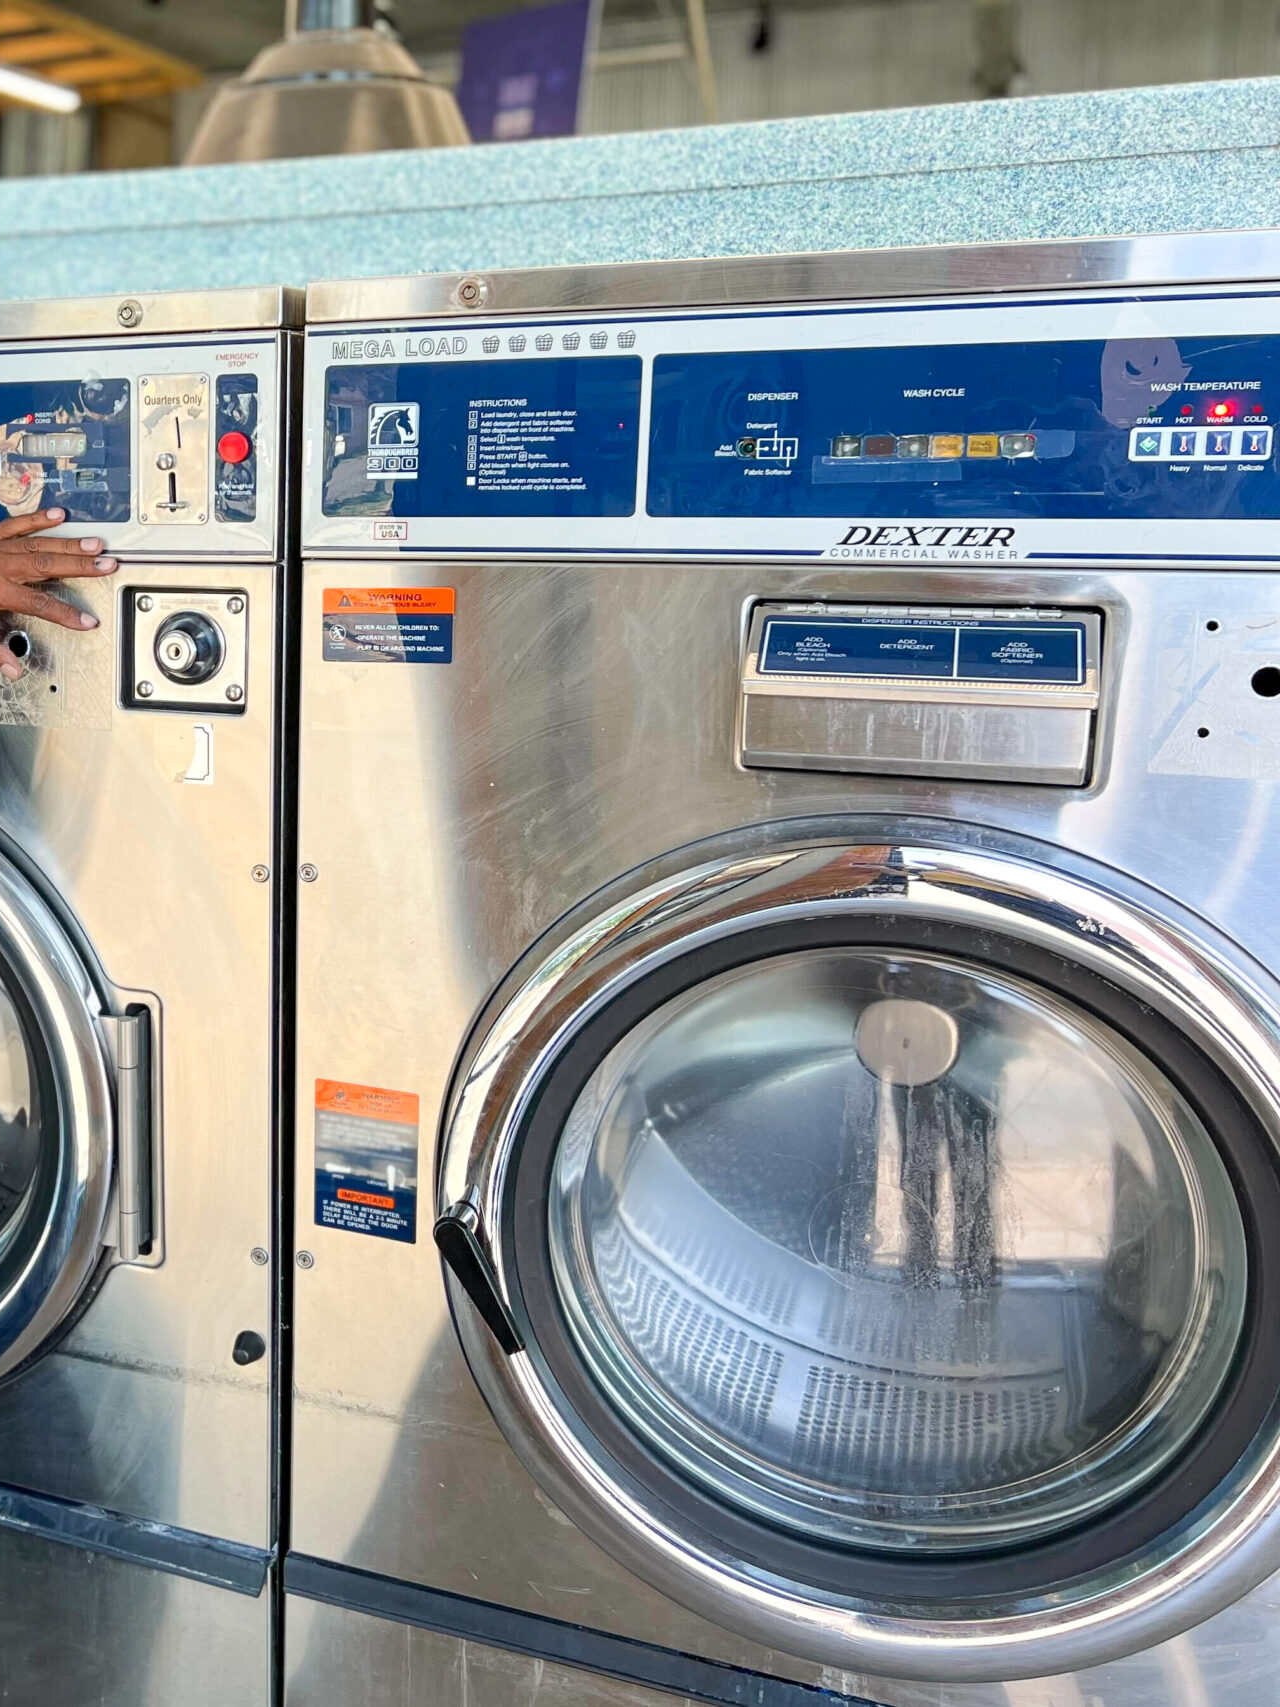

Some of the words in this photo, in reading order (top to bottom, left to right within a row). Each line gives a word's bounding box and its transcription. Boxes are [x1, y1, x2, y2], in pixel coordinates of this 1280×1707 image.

[332, 340, 395, 359] MEGA
[405, 337, 468, 357] LOAD
[1151, 383, 1181, 392] WASH
[1184, 381, 1261, 391] TEMPERATURE
[748, 392, 798, 401] DISPENSER
[903, 390, 931, 398] WASH
[932, 388, 965, 397] CYCLE
[145, 396, 180, 405] Quarters
[183, 394, 202, 406] Only
[469, 399, 528, 407] INSTRUCTIONS
[746, 422, 778, 430] Detergent
[367, 448, 419, 456] THOROUGHBRED
[381, 530, 399, 538] USA
[836, 526, 1015, 547] DEXTER
[830, 548, 938, 558] COMMERCIAL
[948, 549, 1018, 559] WASHER
[330, 1201, 351, 1209] POWER
[323, 1205, 341, 1213] THERE
[387, 1217, 408, 1226] MINUTE
[343, 1214, 365, 1224] BEFORE
[381, 1222, 398, 1230] DOOR
[347, 1221, 371, 1230] OPENED.
